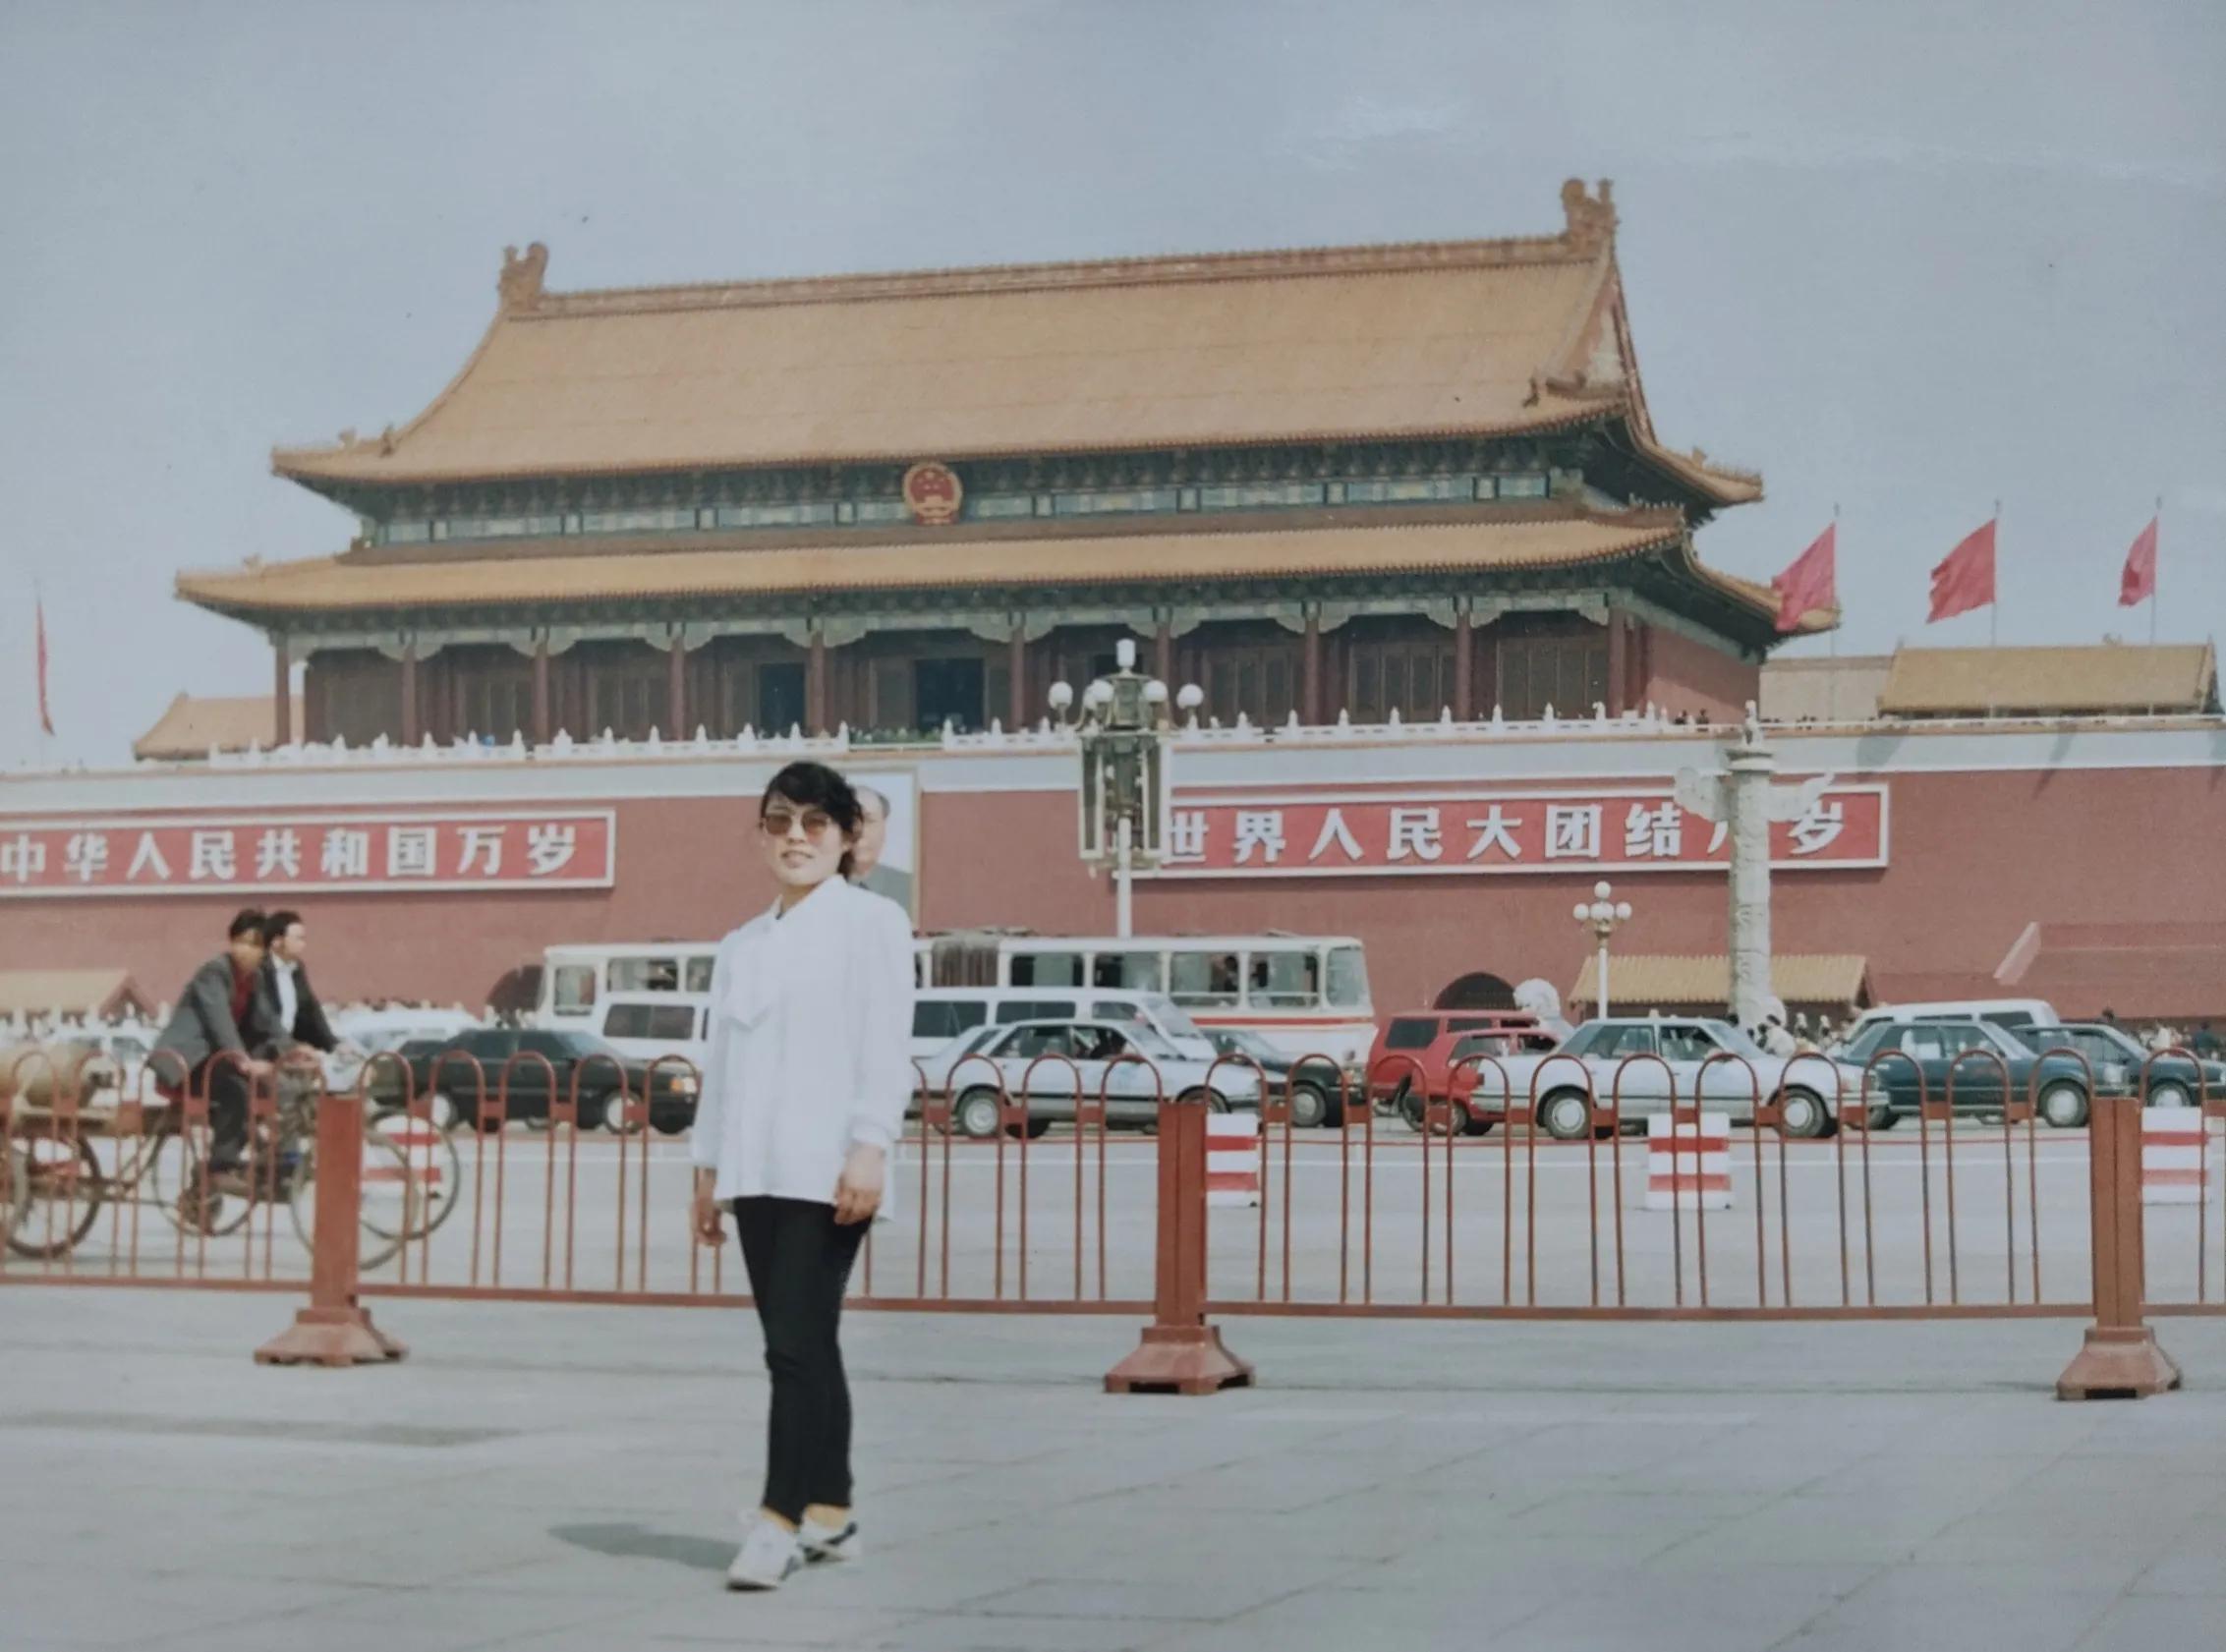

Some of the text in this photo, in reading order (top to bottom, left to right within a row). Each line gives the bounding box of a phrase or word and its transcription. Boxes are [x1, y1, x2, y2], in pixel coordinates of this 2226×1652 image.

[1, 824, 576, 882] 中华人民共和国万岁
[1164, 801, 1843, 865] 世界人民大团结岁
